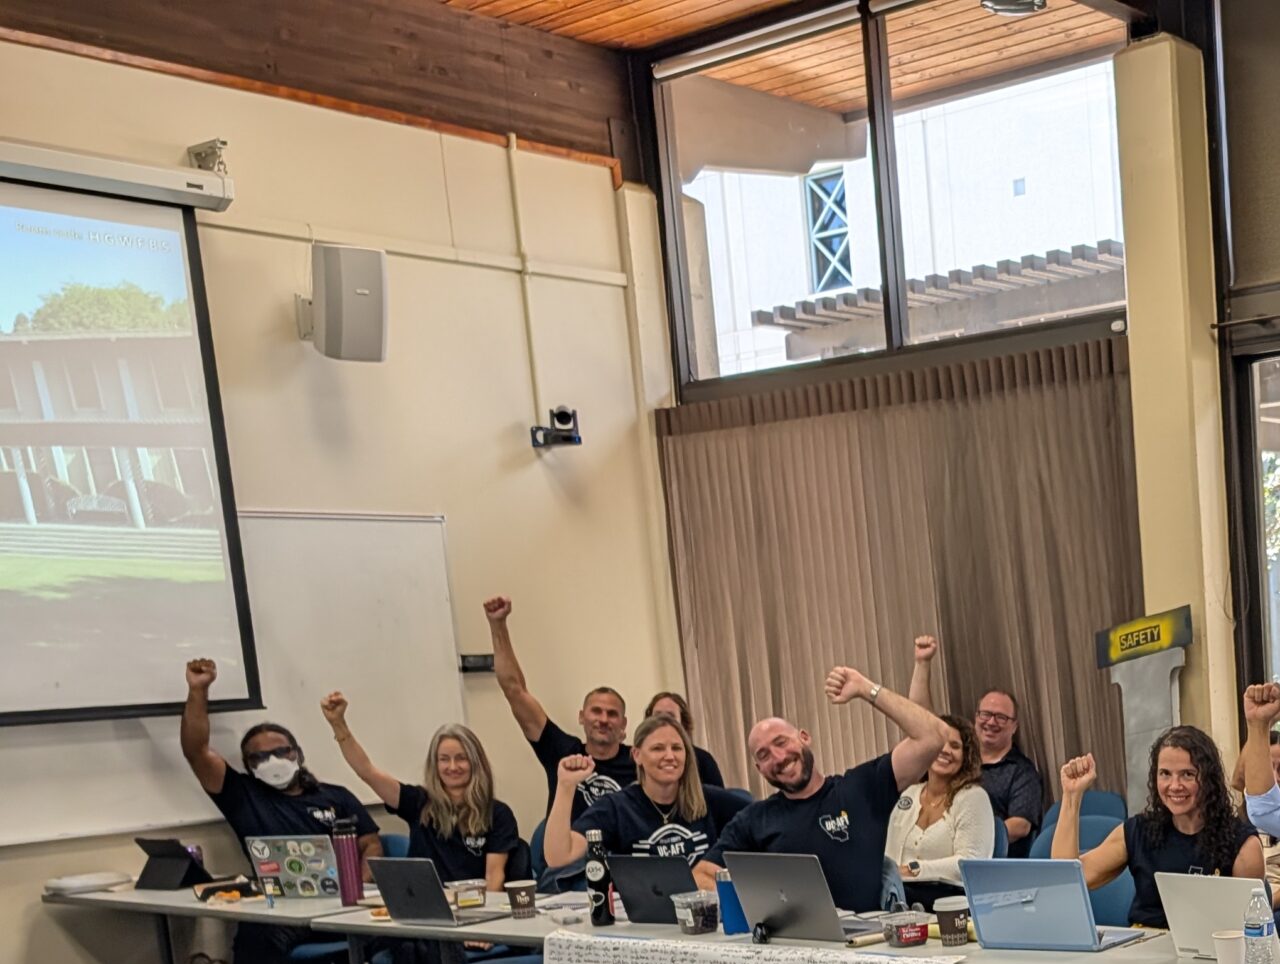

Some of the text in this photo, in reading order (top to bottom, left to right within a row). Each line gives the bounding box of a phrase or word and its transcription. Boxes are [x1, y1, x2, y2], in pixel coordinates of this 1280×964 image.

[1120, 627, 1160, 649] SAFETY
[825, 814, 849, 831] UC-AFT
[657, 842, 685, 857] UC-AFT
